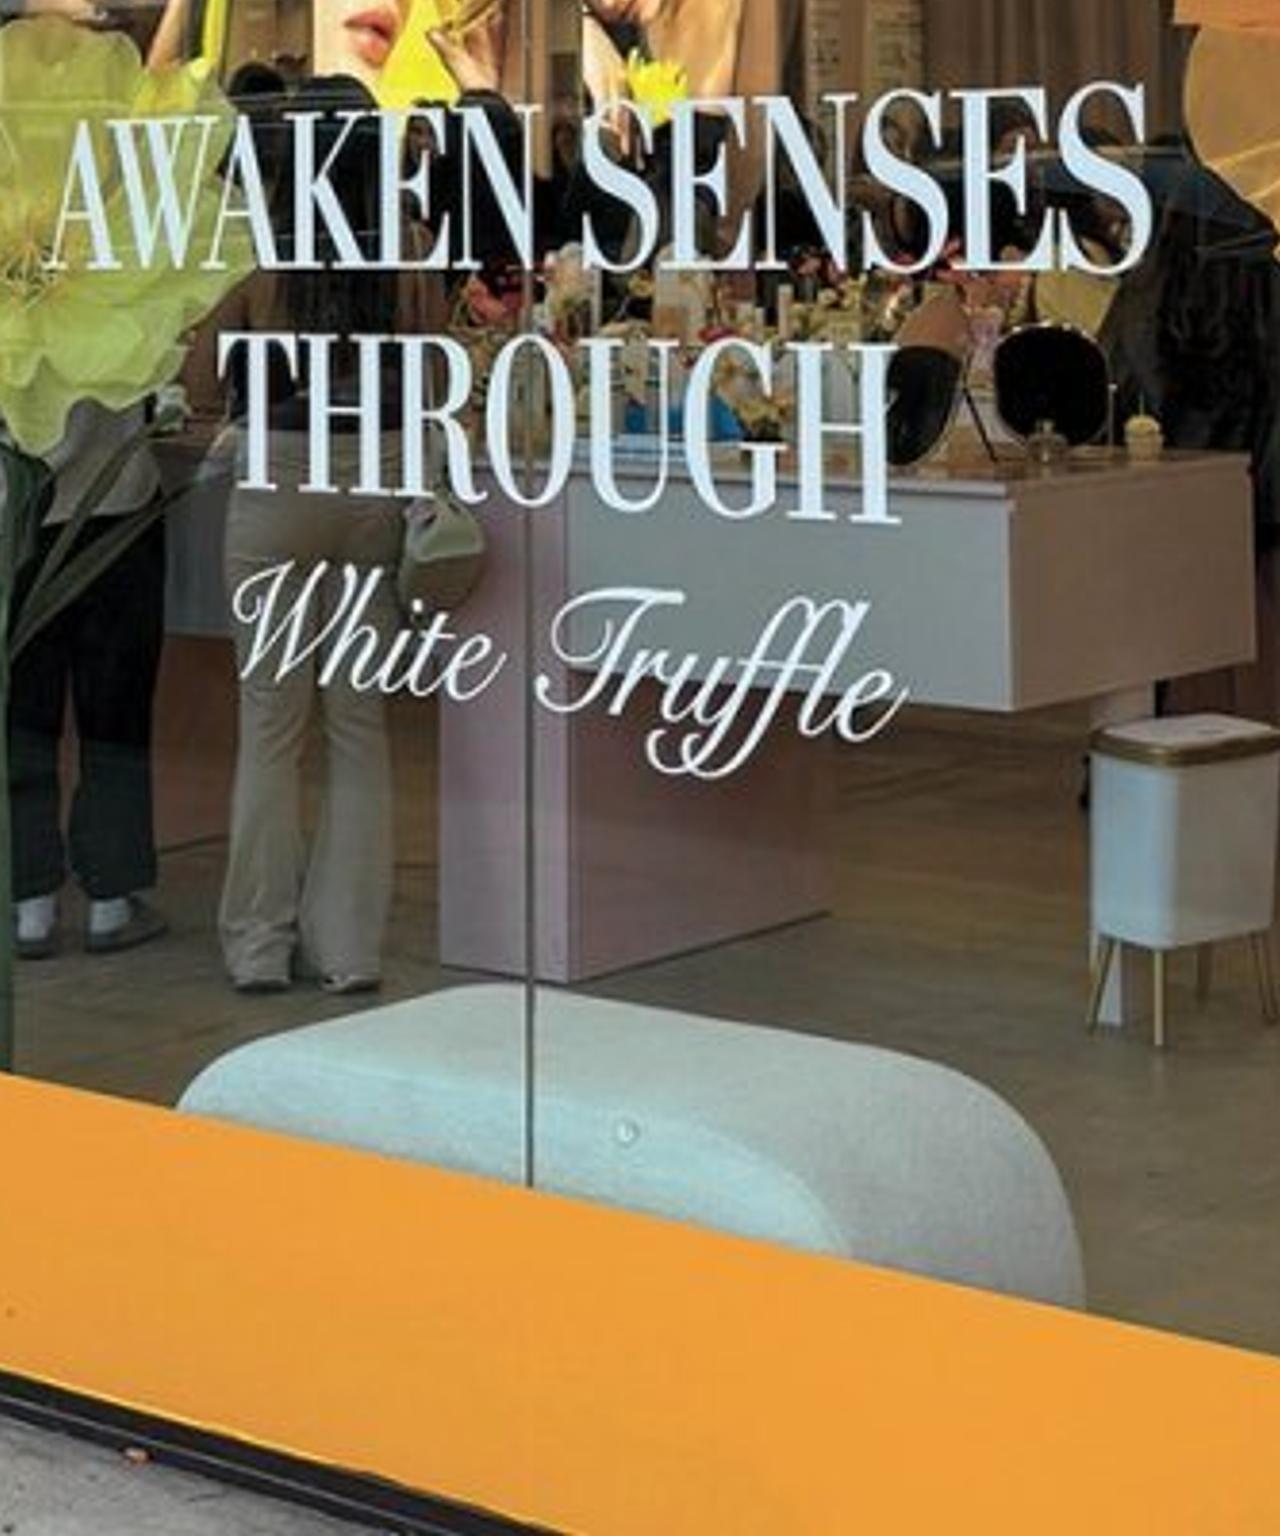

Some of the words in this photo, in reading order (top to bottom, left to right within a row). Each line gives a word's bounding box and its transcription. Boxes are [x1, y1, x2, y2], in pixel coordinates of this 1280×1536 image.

[46, 104, 540, 272] AWAKEN
[581, 81, 1152, 276] SENSES
[217, 331, 903, 525] THROUGH
[232, 559, 508, 702] White
[535, 586, 910, 780] Truffle
